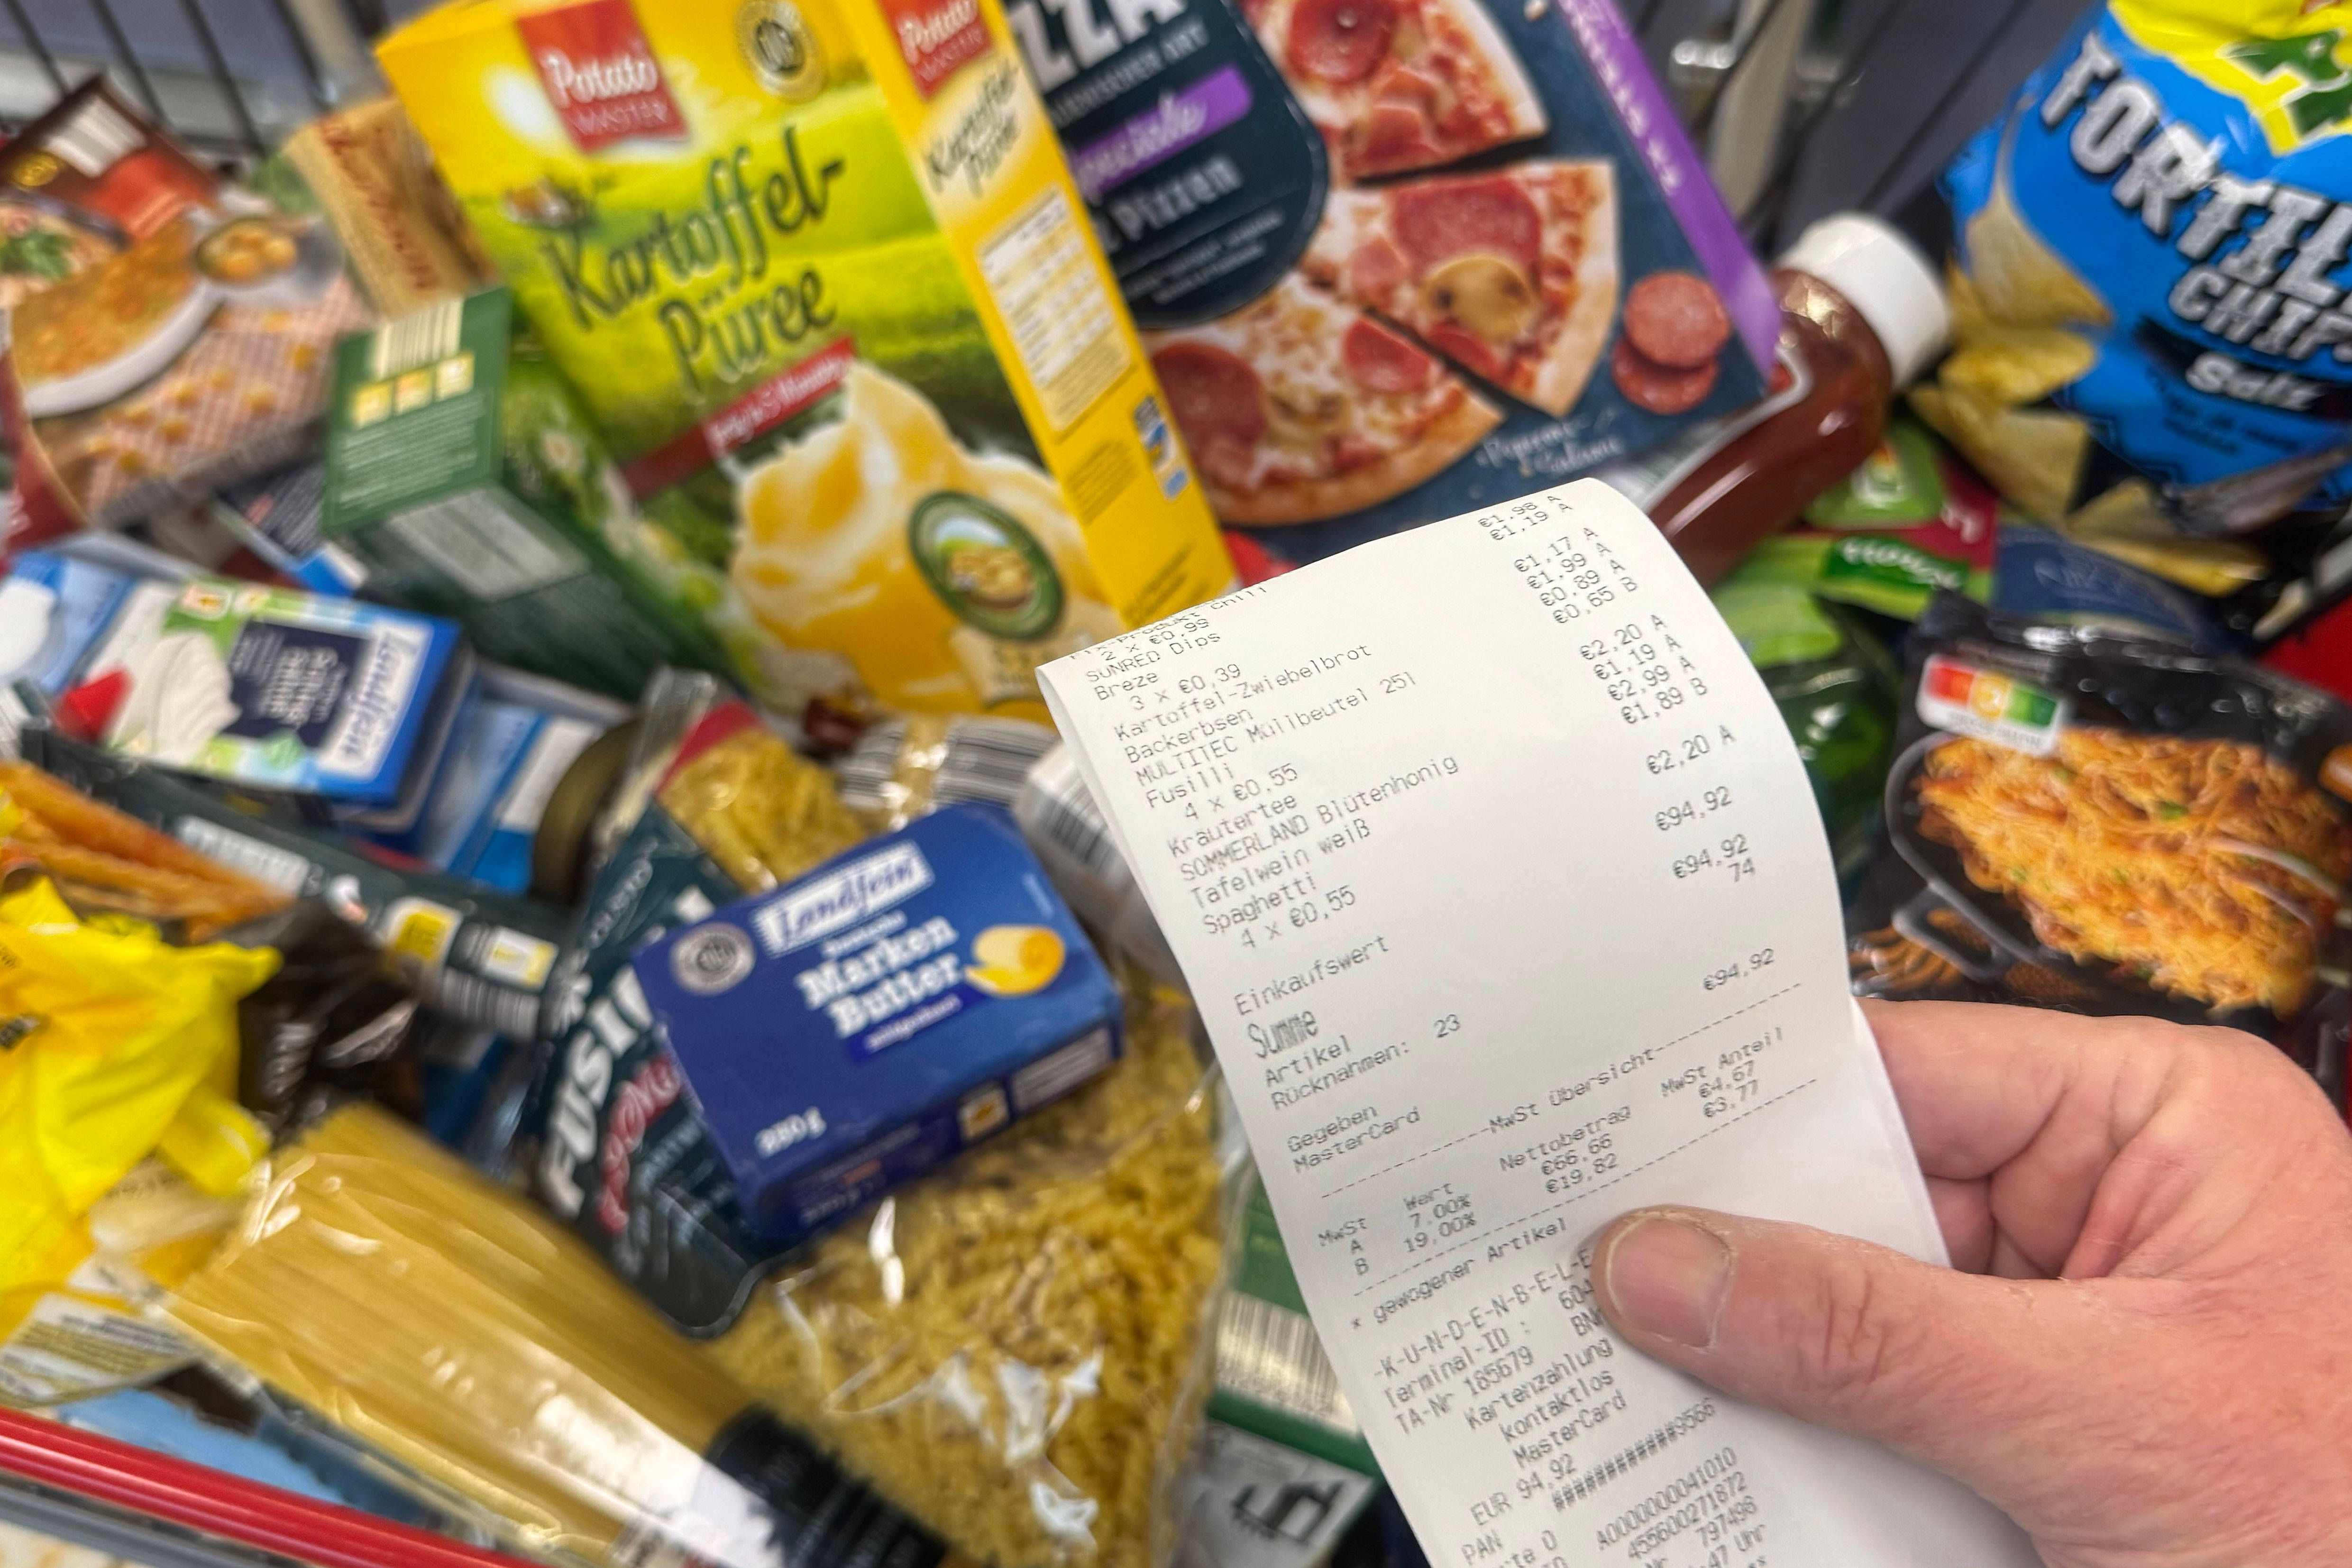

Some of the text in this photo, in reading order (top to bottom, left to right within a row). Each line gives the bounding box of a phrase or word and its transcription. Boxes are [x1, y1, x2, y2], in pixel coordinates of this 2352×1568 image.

[540, 50, 658, 105] Potato
[2040, 32, 2352, 319] TORTIL
[540, 126, 845, 331] Kartoffel-
[658, 268, 835, 404] Püree
[2169, 266, 2352, 362] CHIP
[2186, 352, 2325, 412] Salz
[1087, 651, 1160, 682] SUNRED
[1169, 633, 1221, 655] Dips
[1558, 503, 1574, 513] A
[1130, 696, 1144, 710] 3
[1155, 690, 1170, 702] x
[1583, 527, 1599, 541] A
[1094, 672, 1158, 700] Breze
[1114, 644, 1372, 741] Kartoffel-Zwiebelbrot
[1596, 541, 1612, 556] A
[1125, 708, 1254, 763] Backerbsen
[1610, 559, 1625, 574] A
[1128, 644, 1140, 652] x
[1136, 736, 1238, 787] MULTITEC
[1620, 576, 1638, 592] B
[1167, 795, 1298, 858] Kräutertee
[1665, 634, 1682, 652] A
[1185, 803, 1198, 820] 4
[1208, 797, 1224, 812] x
[1651, 614, 1667, 631] A
[1146, 764, 1234, 808] Fusilli
[1181, 814, 1309, 882] SOMMERLAND
[1317, 756, 1459, 825] Blütenhonig
[1679, 655, 1695, 673] A
[1190, 848, 1310, 908] Tafelwein
[1318, 818, 1372, 854] weiß
[1690, 677, 1708, 696] B
[1241, 928, 1256, 950] 4
[1265, 922, 1282, 940] x
[1719, 724, 1737, 745] A
[778, 856, 915, 948] Landfein
[1203, 871, 1318, 935] Spaghetti
[794, 915, 959, 1010] Marken
[825, 953, 964, 1039] Butter
[1233, 935, 1389, 1017] Einkaufswert
[1265, 857, 1756, 1088] Artikel 74
[1248, 1010, 1318, 1059] Summe
[1271, 1014, 1461, 1110] Rücknahmen: 23
[1287, 1106, 1378, 1152] Gegeben
[1293, 1106, 1420, 1173] MasterCard
[1317, 1027, 1784, 1247] MwSt Wert Nettobetrag MwSt Anteil
[1350, 1238, 1364, 1254] A
[1354, 1258, 1369, 1275] B
[1374, 1218, 1567, 1323] gewogener Artikel
[1384, 1328, 1510, 1409] Terminal-ID
[1394, 1393, 1454, 1435] TA-Nr
[1464, 1338, 1614, 1430] Kartenzahlung
[1499, 1370, 1614, 1443] kontaktlos
[1512, 1388, 1627, 1470] MasterCard
[1461, 1529, 1502, 1566] PAN
[1470, 1492, 1512, 1526] EUR
